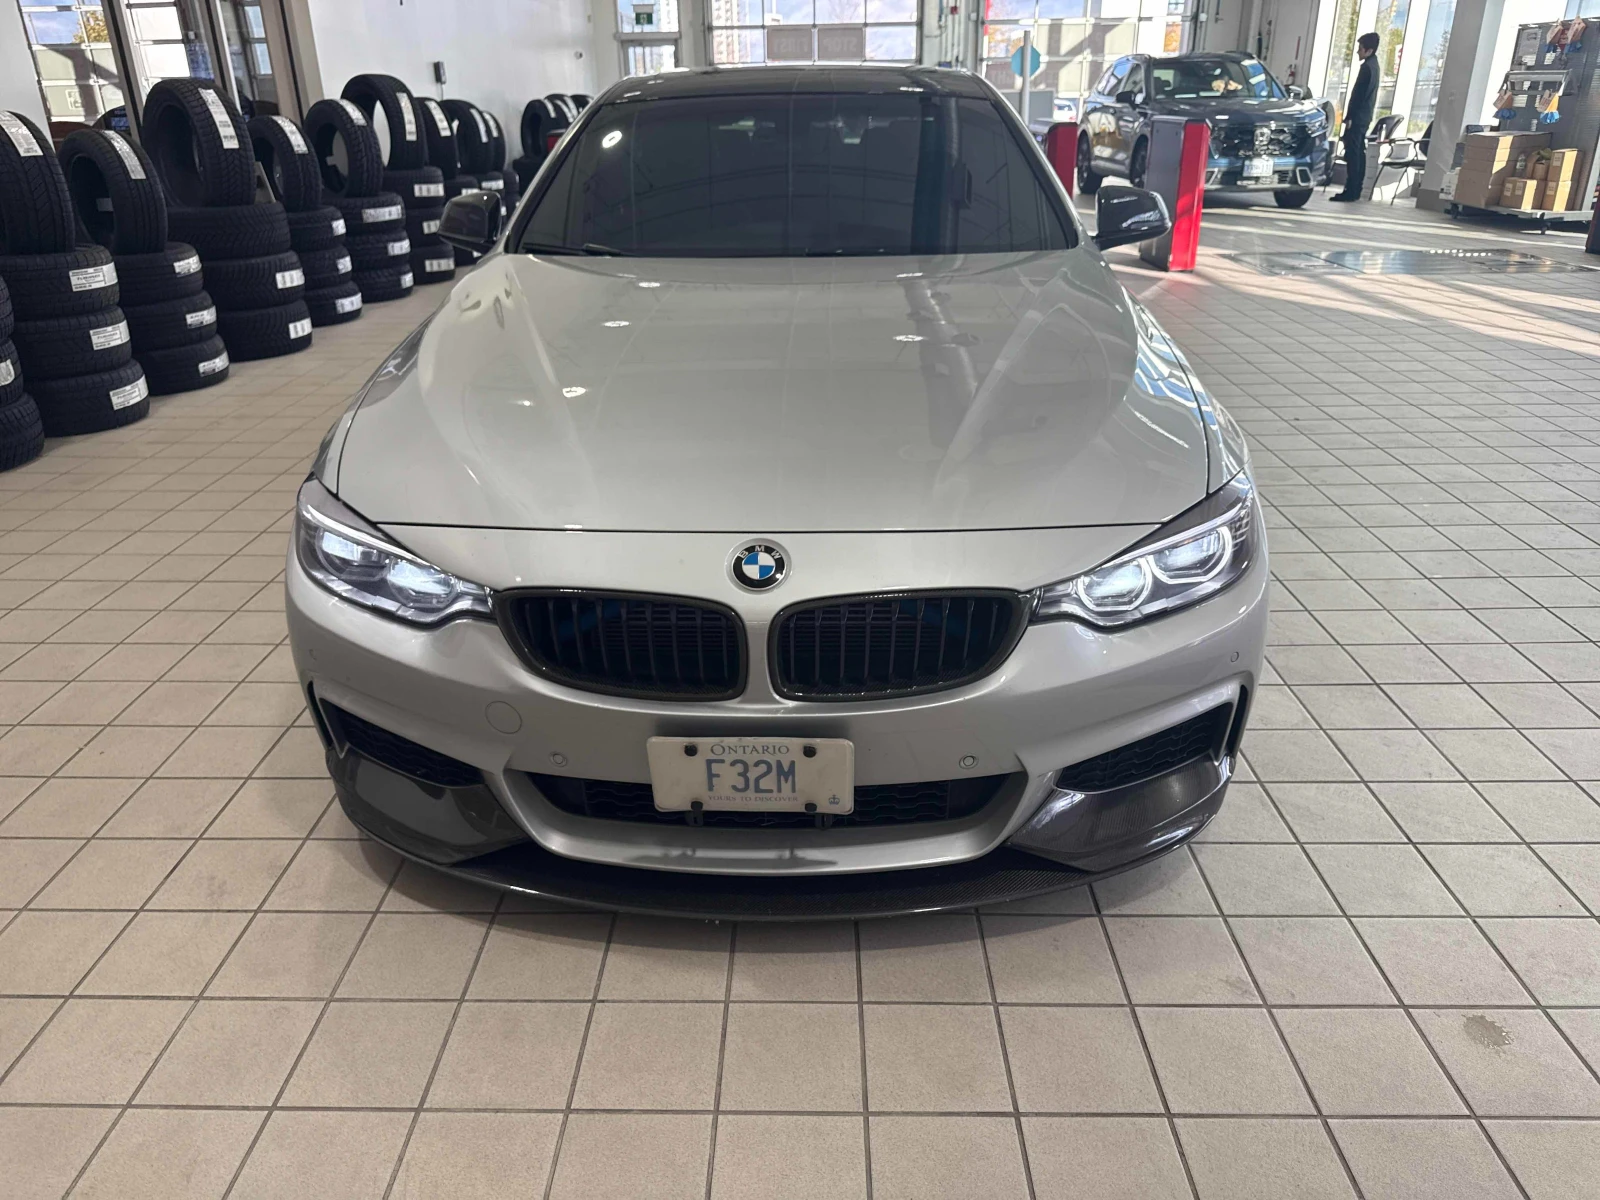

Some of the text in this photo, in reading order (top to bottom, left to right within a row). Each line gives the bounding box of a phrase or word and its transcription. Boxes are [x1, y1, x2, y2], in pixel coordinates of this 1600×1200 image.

[737, 545, 782, 560] BMW
[711, 744, 790, 756] ONTARIO
[706, 759, 796, 793] F32M
